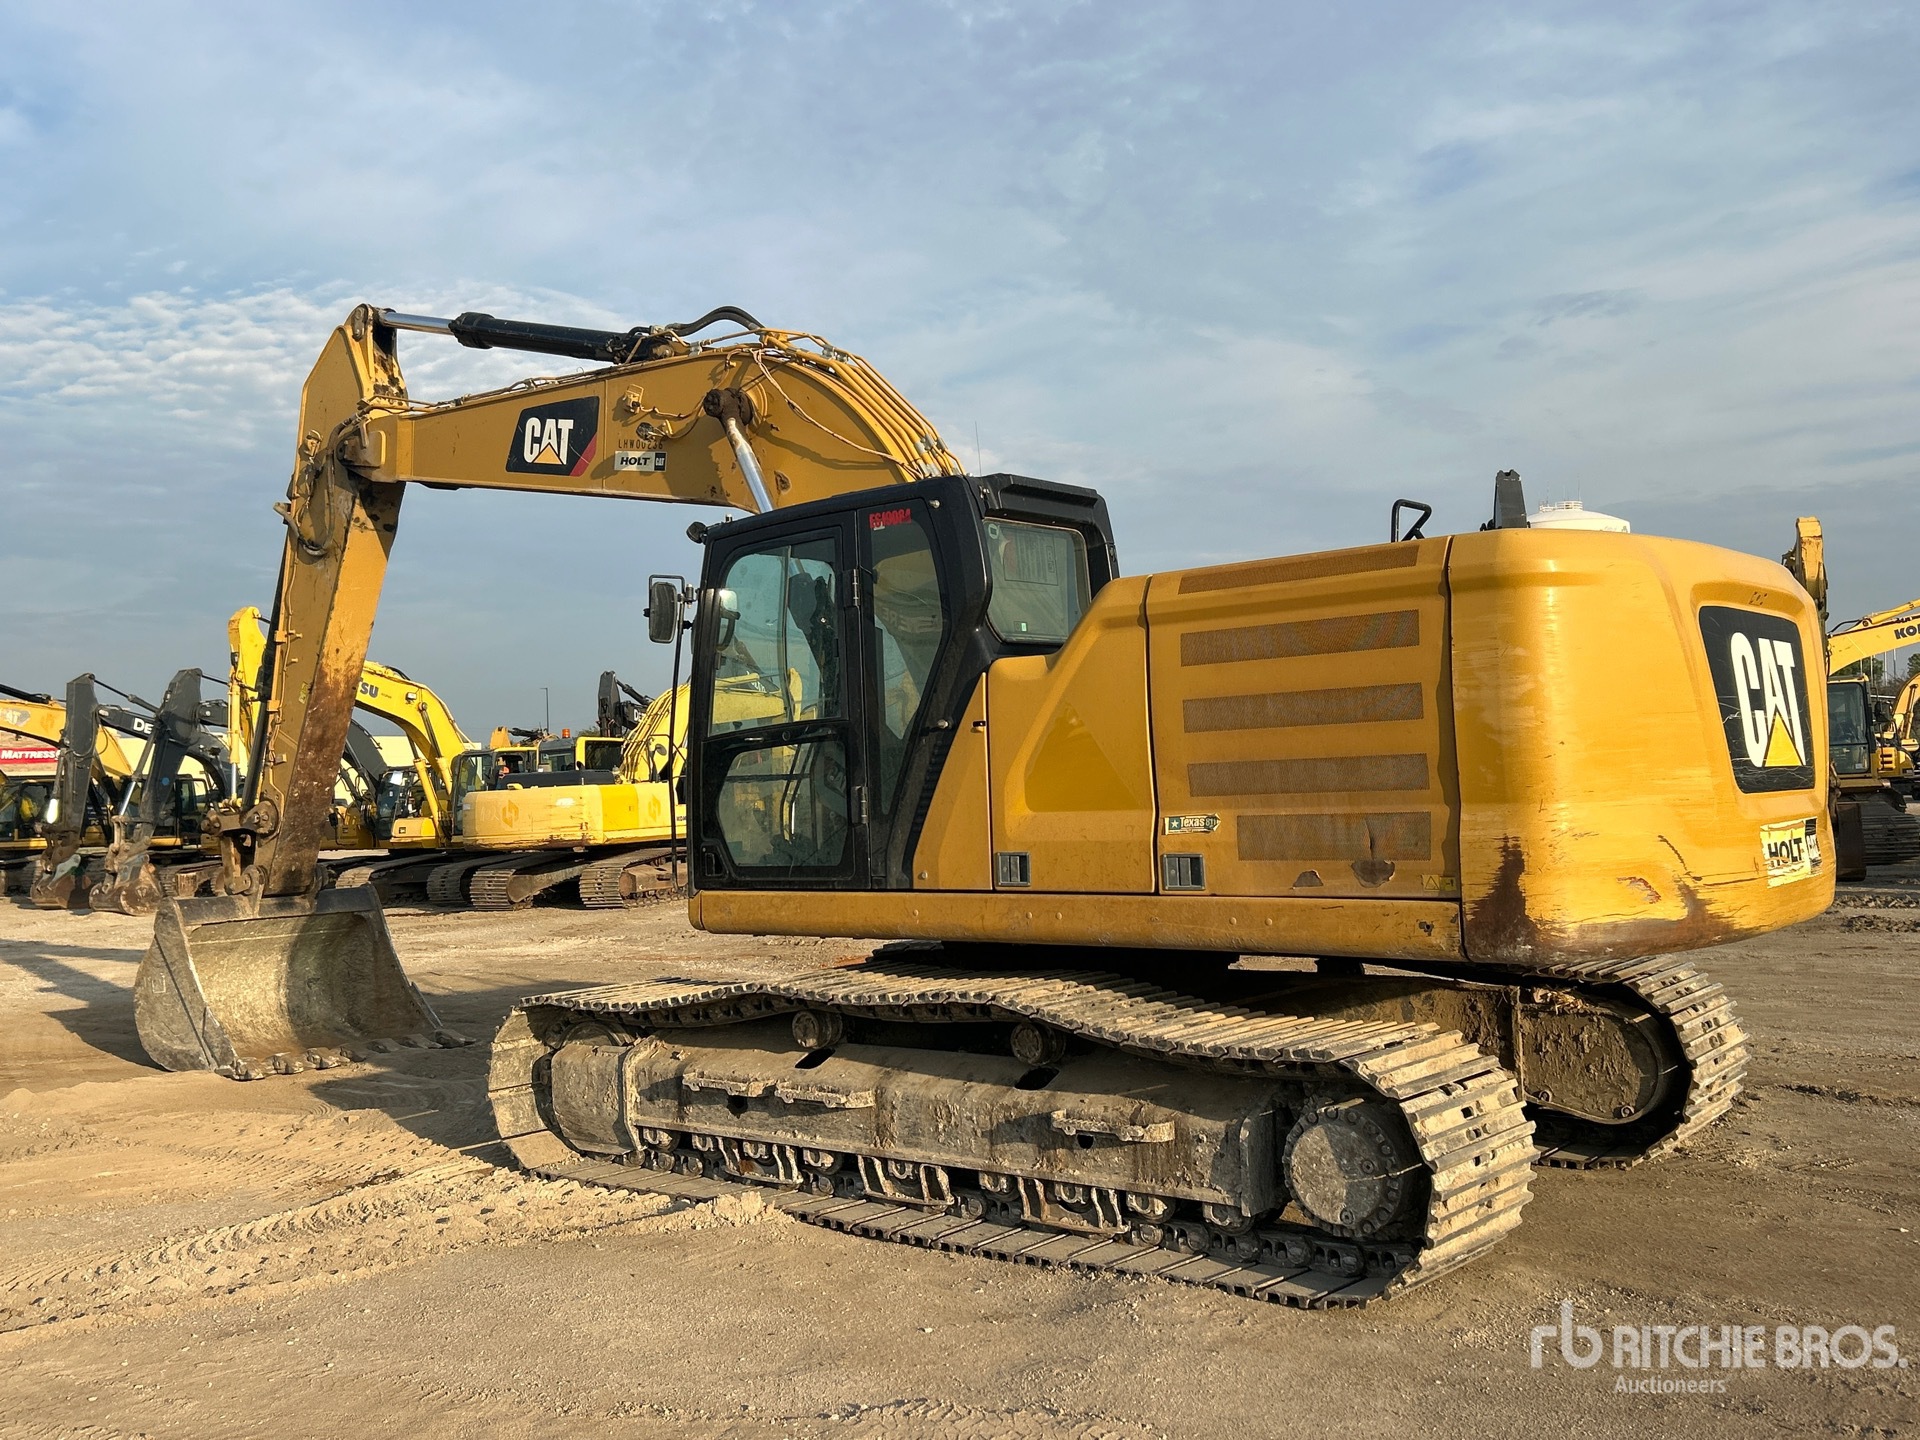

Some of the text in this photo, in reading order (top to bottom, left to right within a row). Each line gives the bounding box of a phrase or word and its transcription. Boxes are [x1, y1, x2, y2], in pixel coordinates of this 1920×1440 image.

[523, 417, 574, 465] CAT
[620, 456, 650, 466] HOLT
[1894, 624, 1920, 640] KO
[1730, 631, 1806, 768] CAT
[1767, 837, 1802, 867] HOLT
